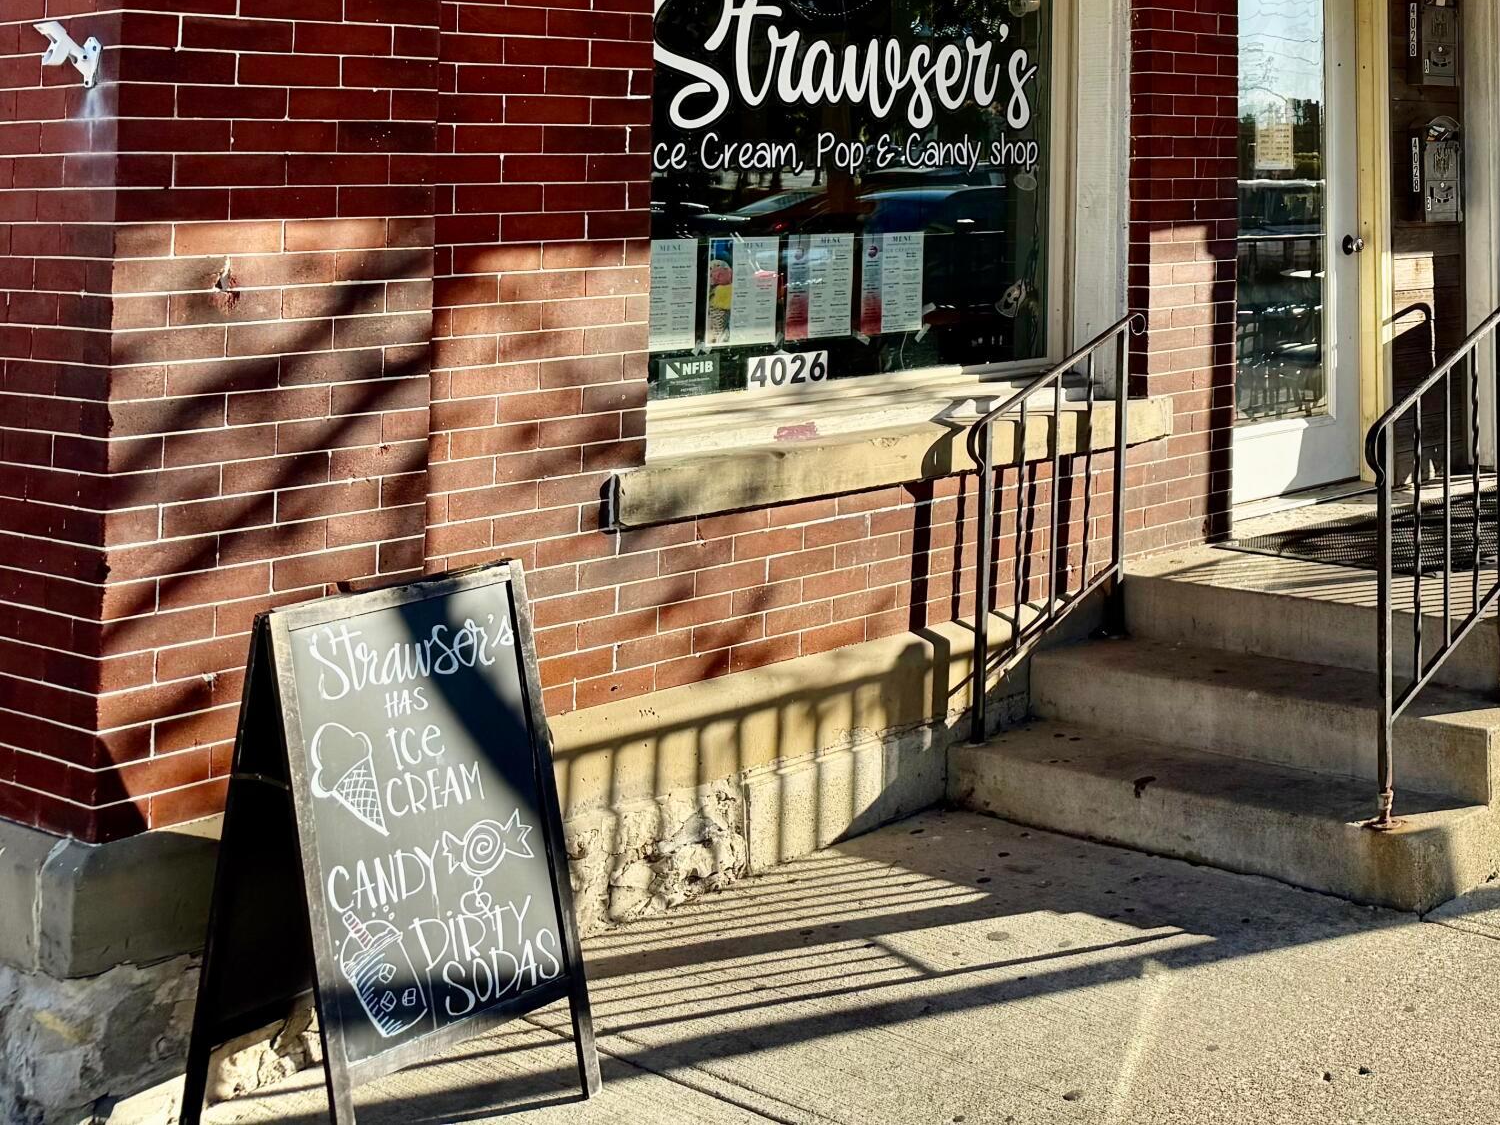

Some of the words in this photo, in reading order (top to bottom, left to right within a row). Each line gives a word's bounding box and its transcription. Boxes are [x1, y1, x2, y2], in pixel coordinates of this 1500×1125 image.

[653, 141, 687, 171] ce
[700, 132, 805, 174] Cream,
[816, 132, 864, 175] Pop
[876, 134, 894, 165] &
[905, 132, 980, 174] Candy
[990, 132, 1038, 174] shop
[682, 360, 714, 376] NFIB
[750, 352, 826, 389] 4026
[309, 614, 514, 700] Strawser's
[384, 687, 429, 718] HAS
[386, 761, 485, 816] CREAM
[327, 840, 442, 913] CANDY
[460, 876, 496, 931] &
[443, 928, 560, 1016] SODAS
